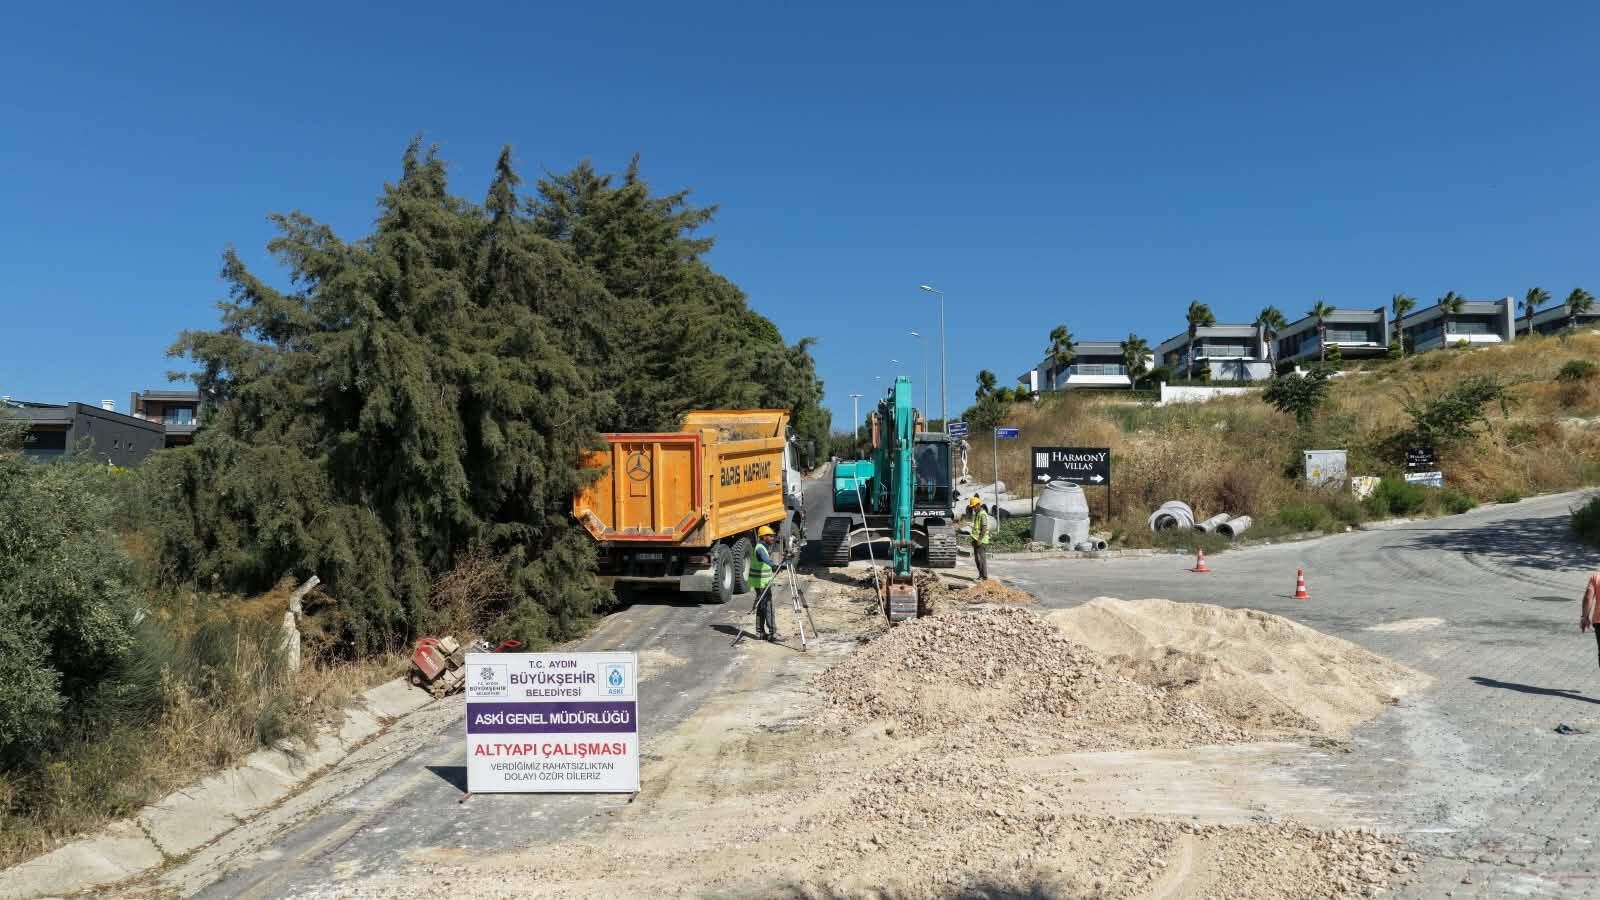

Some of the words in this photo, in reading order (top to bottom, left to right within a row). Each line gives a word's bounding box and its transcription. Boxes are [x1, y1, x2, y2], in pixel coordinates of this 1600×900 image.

[1052, 451, 1106, 462] HARMONY
[1064, 462, 1093, 471] VILLAS
[529, 660, 545, 669] T.C.
[549, 660, 577, 668] AYDIN
[510, 671, 596, 686] BÜYÜKŞEHİR
[526, 687, 581, 697] BELEDİYESİ
[474, 711, 504, 725] ASKİ
[505, 713, 548, 725] GENEL
[549, 710, 630, 724] MÜDÜRLÜĞÜ
[474, 743, 537, 756] ALTYAPI
[541, 742, 627, 758] ÇALIŞMASI
[490, 760, 540, 771] VERDİĞİMİZ
[542, 761, 614, 770] RAHATSIZLIKTAN
[504, 772, 537, 780] DOLAYI
[538, 771, 564, 780] ÖZÜR
[566, 770, 601, 780] DİLERİZ
